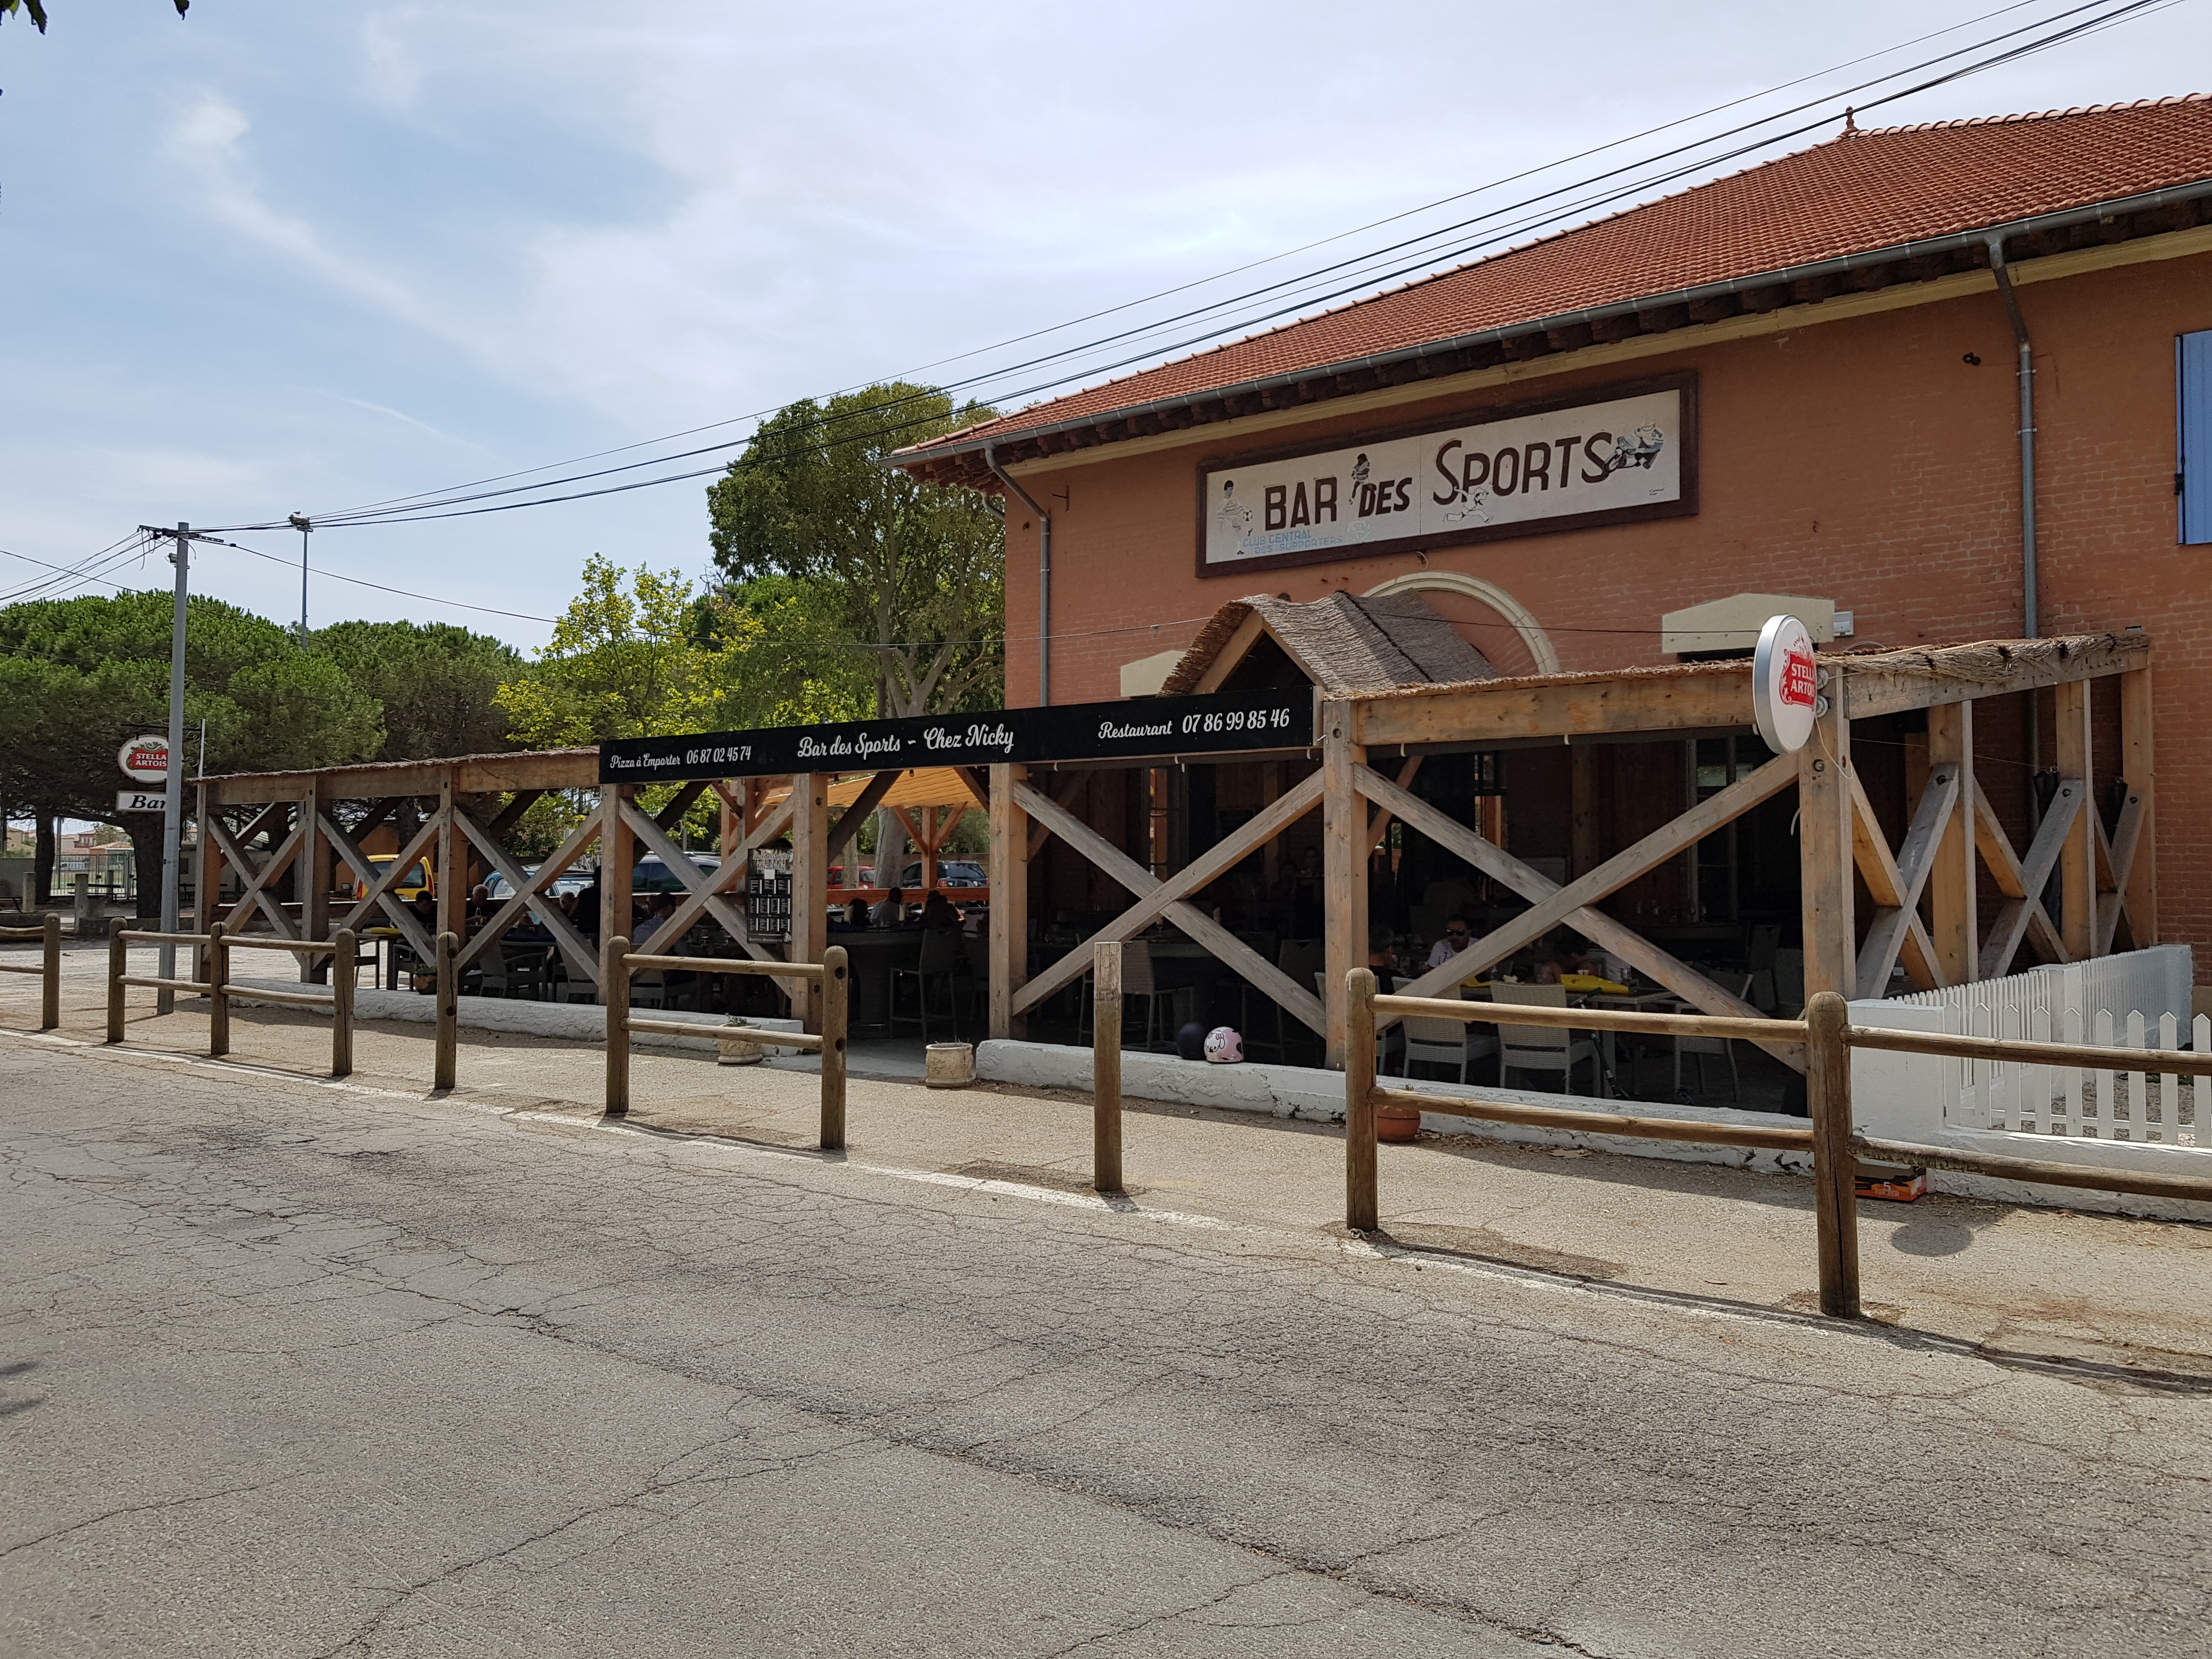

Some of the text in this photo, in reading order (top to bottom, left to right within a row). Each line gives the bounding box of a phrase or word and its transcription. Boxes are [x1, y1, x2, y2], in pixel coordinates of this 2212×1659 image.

[1265, 432, 1612, 531] BAR DES SPORTS
[1243, 529, 1312, 548] CLUB CENTRAL
[1255, 535, 1343, 555] DES SUPPORTERS
[1098, 708, 1290, 739] Restaurant 07 86 99 85 46
[797, 736, 828, 758] Bar
[830, 735, 852, 755] des
[855, 732, 901, 760] Sports
[923, 727, 962, 749] Chez
[965, 723, 1014, 754] Nicky
[610, 746, 751, 770] Pizza à Emporter 06 87 02 45 74
[128, 795, 166, 809] Bar
[1883, 1182, 1891, 1192] 5
